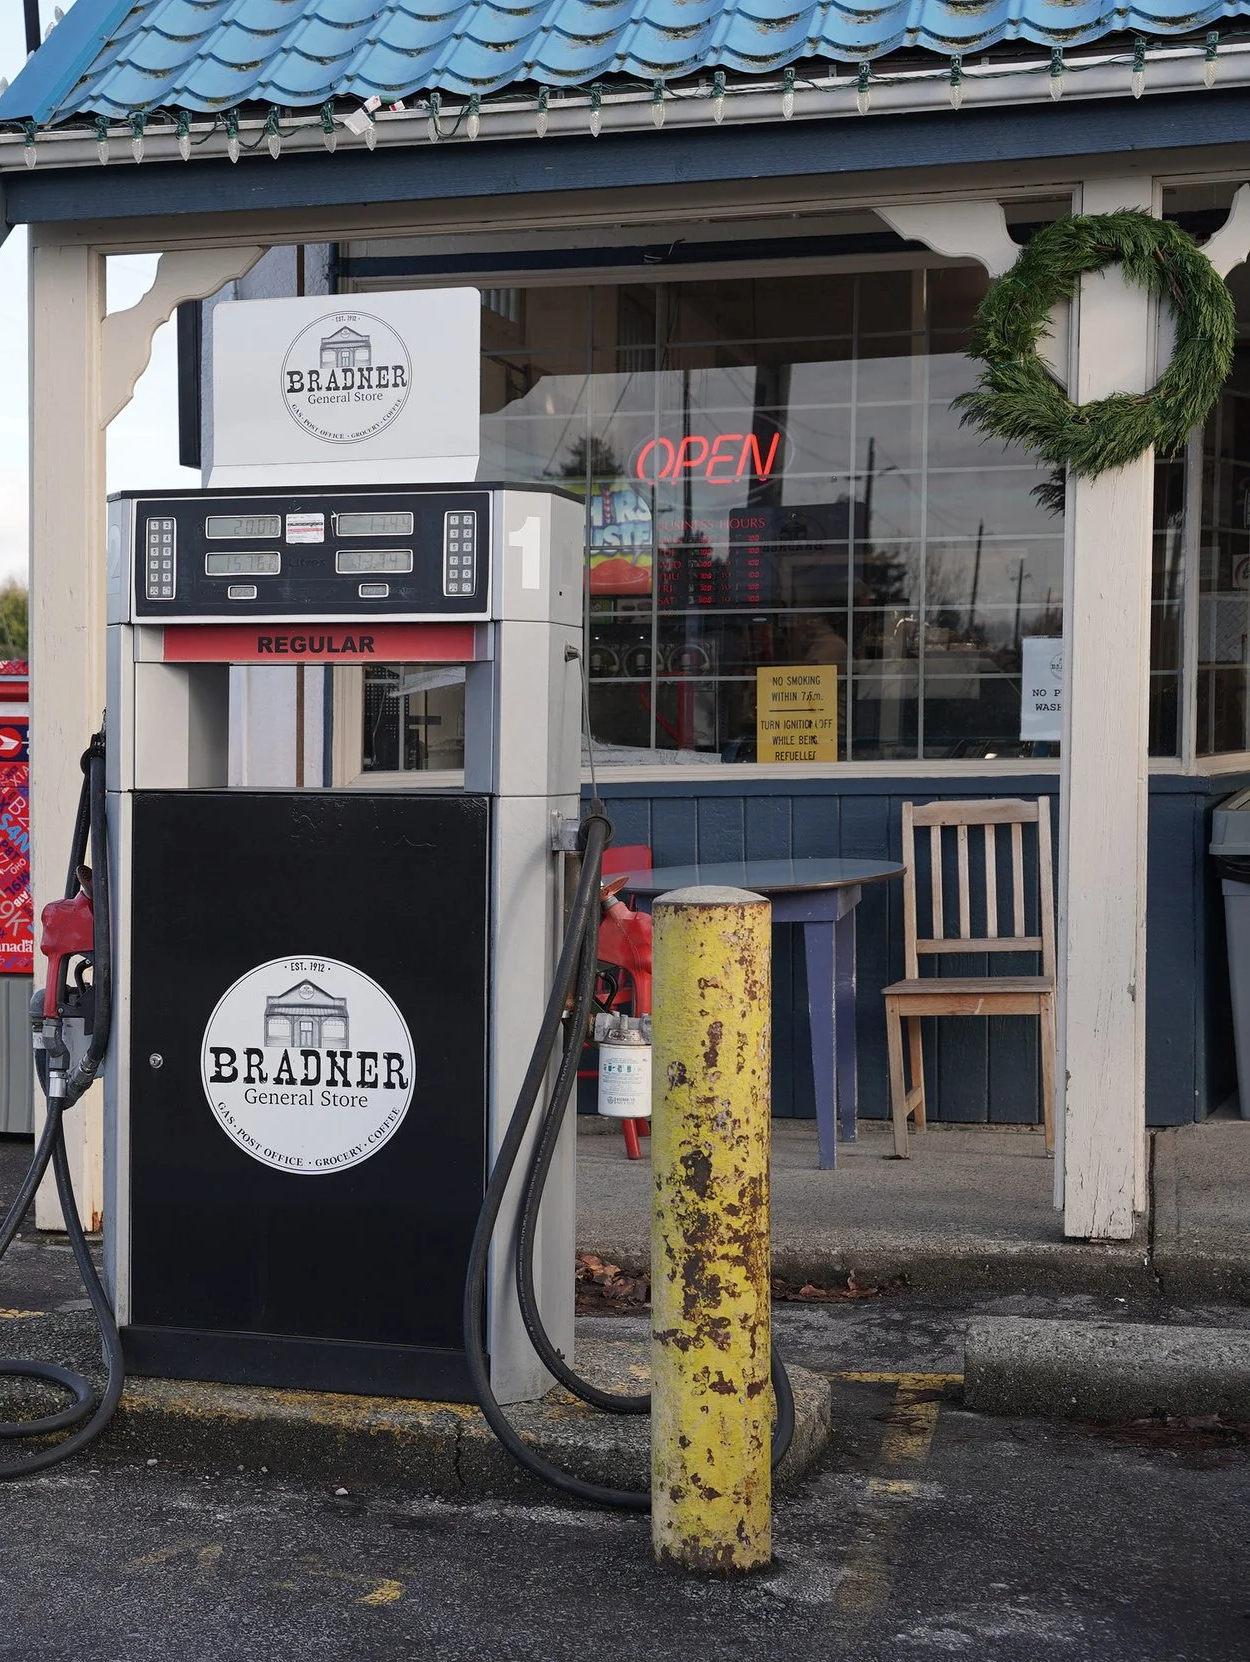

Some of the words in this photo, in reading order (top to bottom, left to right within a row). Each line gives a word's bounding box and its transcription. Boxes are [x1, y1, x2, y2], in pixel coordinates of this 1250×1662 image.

[287, 365, 407, 394] BRADNER
[308, 392, 350, 404] General
[354, 391, 383, 402] Store
[292, 403, 303, 418] GAS
[303, 419, 319, 432] POST
[320, 427, 345, 439] OFFICE
[350, 422, 381, 439] GROCERY
[382, 398, 403, 422] COFFEE
[636, 432, 780, 486] OPEN
[719, 517, 767, 529] HOURS
[508, 516, 540, 590] 1
[258, 636, 374, 652] REGULAR
[772, 676, 783, 686] NO
[786, 675, 821, 686] SMOKING
[772, 691, 798, 702] WITHIN
[1032, 689, 1047, 697] NO
[760, 720, 780, 730] TURN
[772, 736, 795, 745] WHILE
[13, 891, 29, 907] A1B
[290, 962, 307, 972] EST.
[310, 962, 326, 972] 1912
[209, 1046, 409, 1090] BRADNER
[244, 1088, 314, 1106] General
[320, 1090, 368, 1108] Store
[217, 1102, 236, 1124] GAS
[236, 1128, 262, 1151] POST
[263, 1148, 304, 1167] OFFICE
[315, 1143, 363, 1167] GROCERY
[367, 1106, 400, 1144] COFFEE
